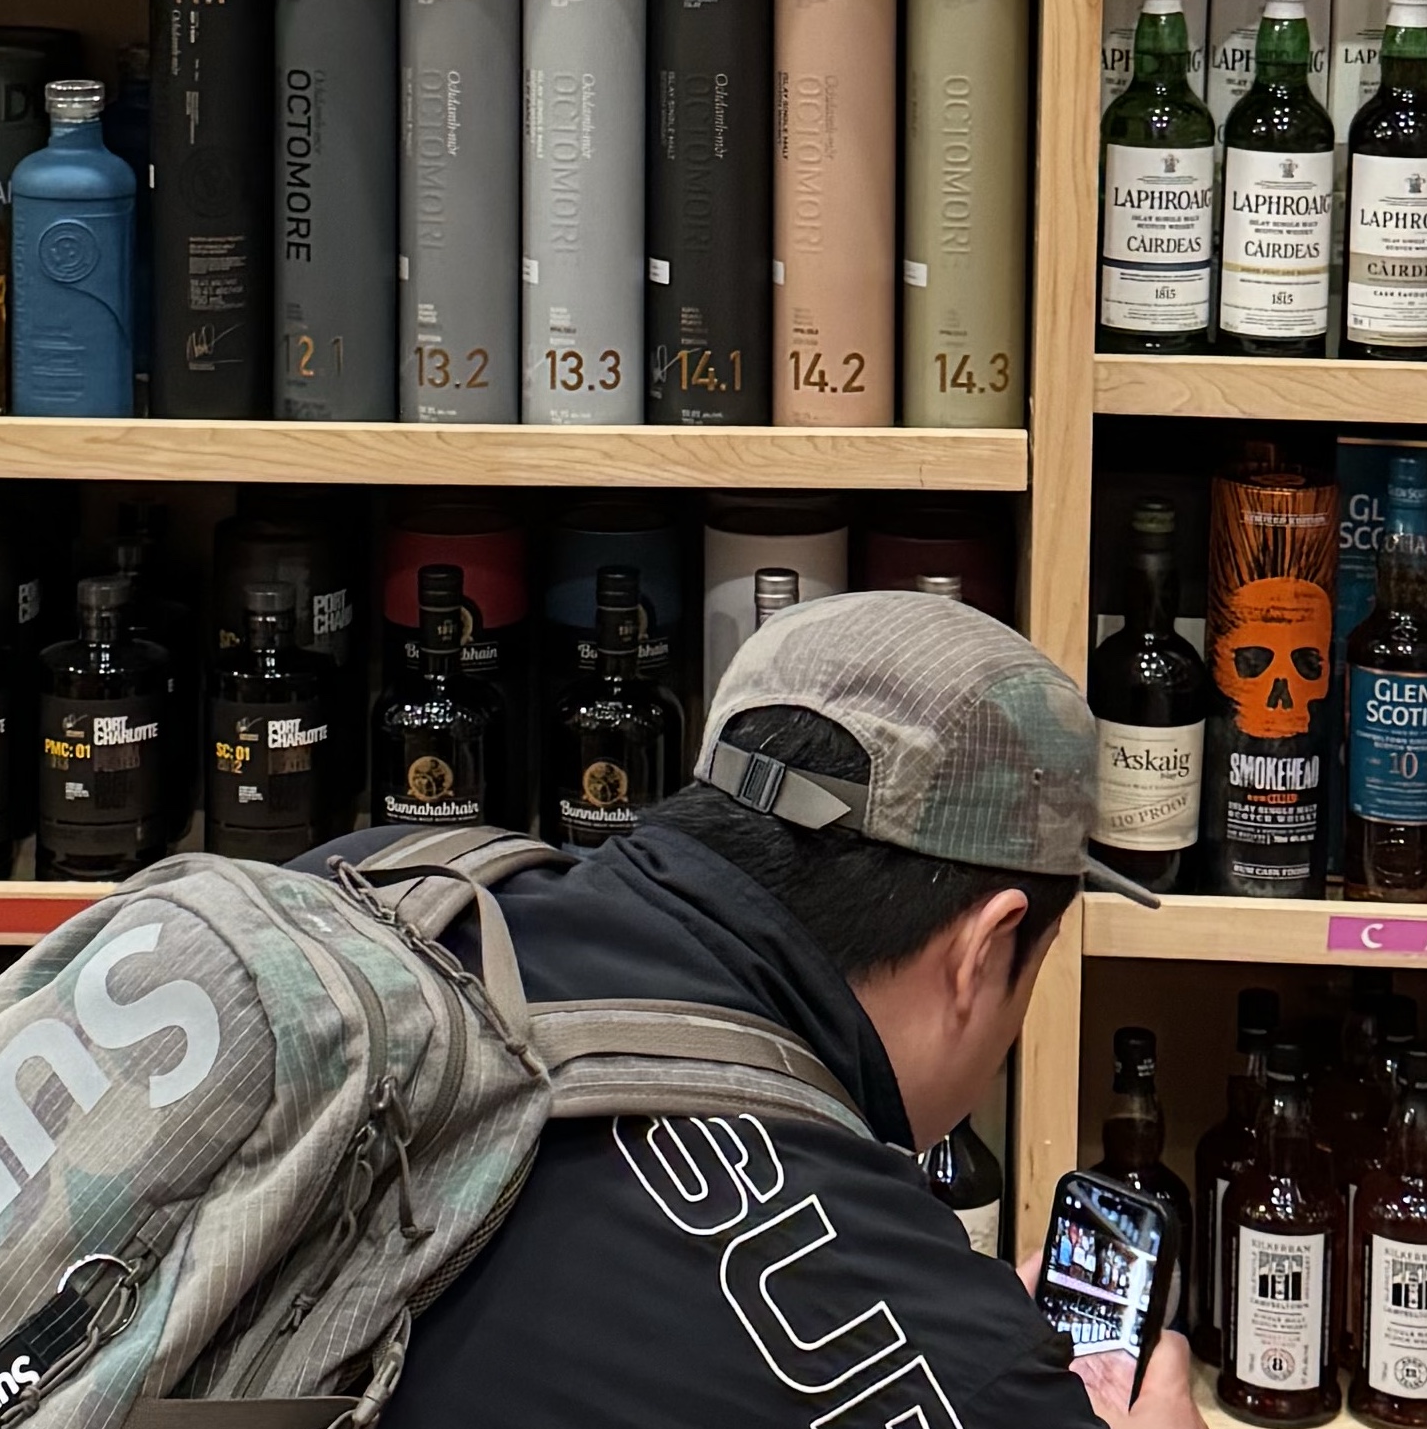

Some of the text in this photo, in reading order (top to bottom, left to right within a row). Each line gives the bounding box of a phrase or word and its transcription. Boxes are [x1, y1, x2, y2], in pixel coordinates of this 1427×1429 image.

[286, 69, 312, 263] OCTOMORE
[1126, 235, 1202, 254] CÀIRDEAS
[414, 345, 490, 389] 13.2
[545, 349, 621, 391] 13.3
[677, 348, 743, 392] 14.1
[789, 350, 866, 393] 14.2
[934, 351, 1010, 394] 14.3
[94, 716, 129, 734] PORT
[268, 719, 304, 739] PORT
[75, 744, 91, 759] 01
[1111, 746, 1192, 776] Askaig
[1389, 752, 1418, 779] 10
[1230, 753, 1319, 791] SMOKEHEAD
[1140, 795, 1188, 823] PROOF
[1251, 1239, 1311, 1254] KILKERRAN
